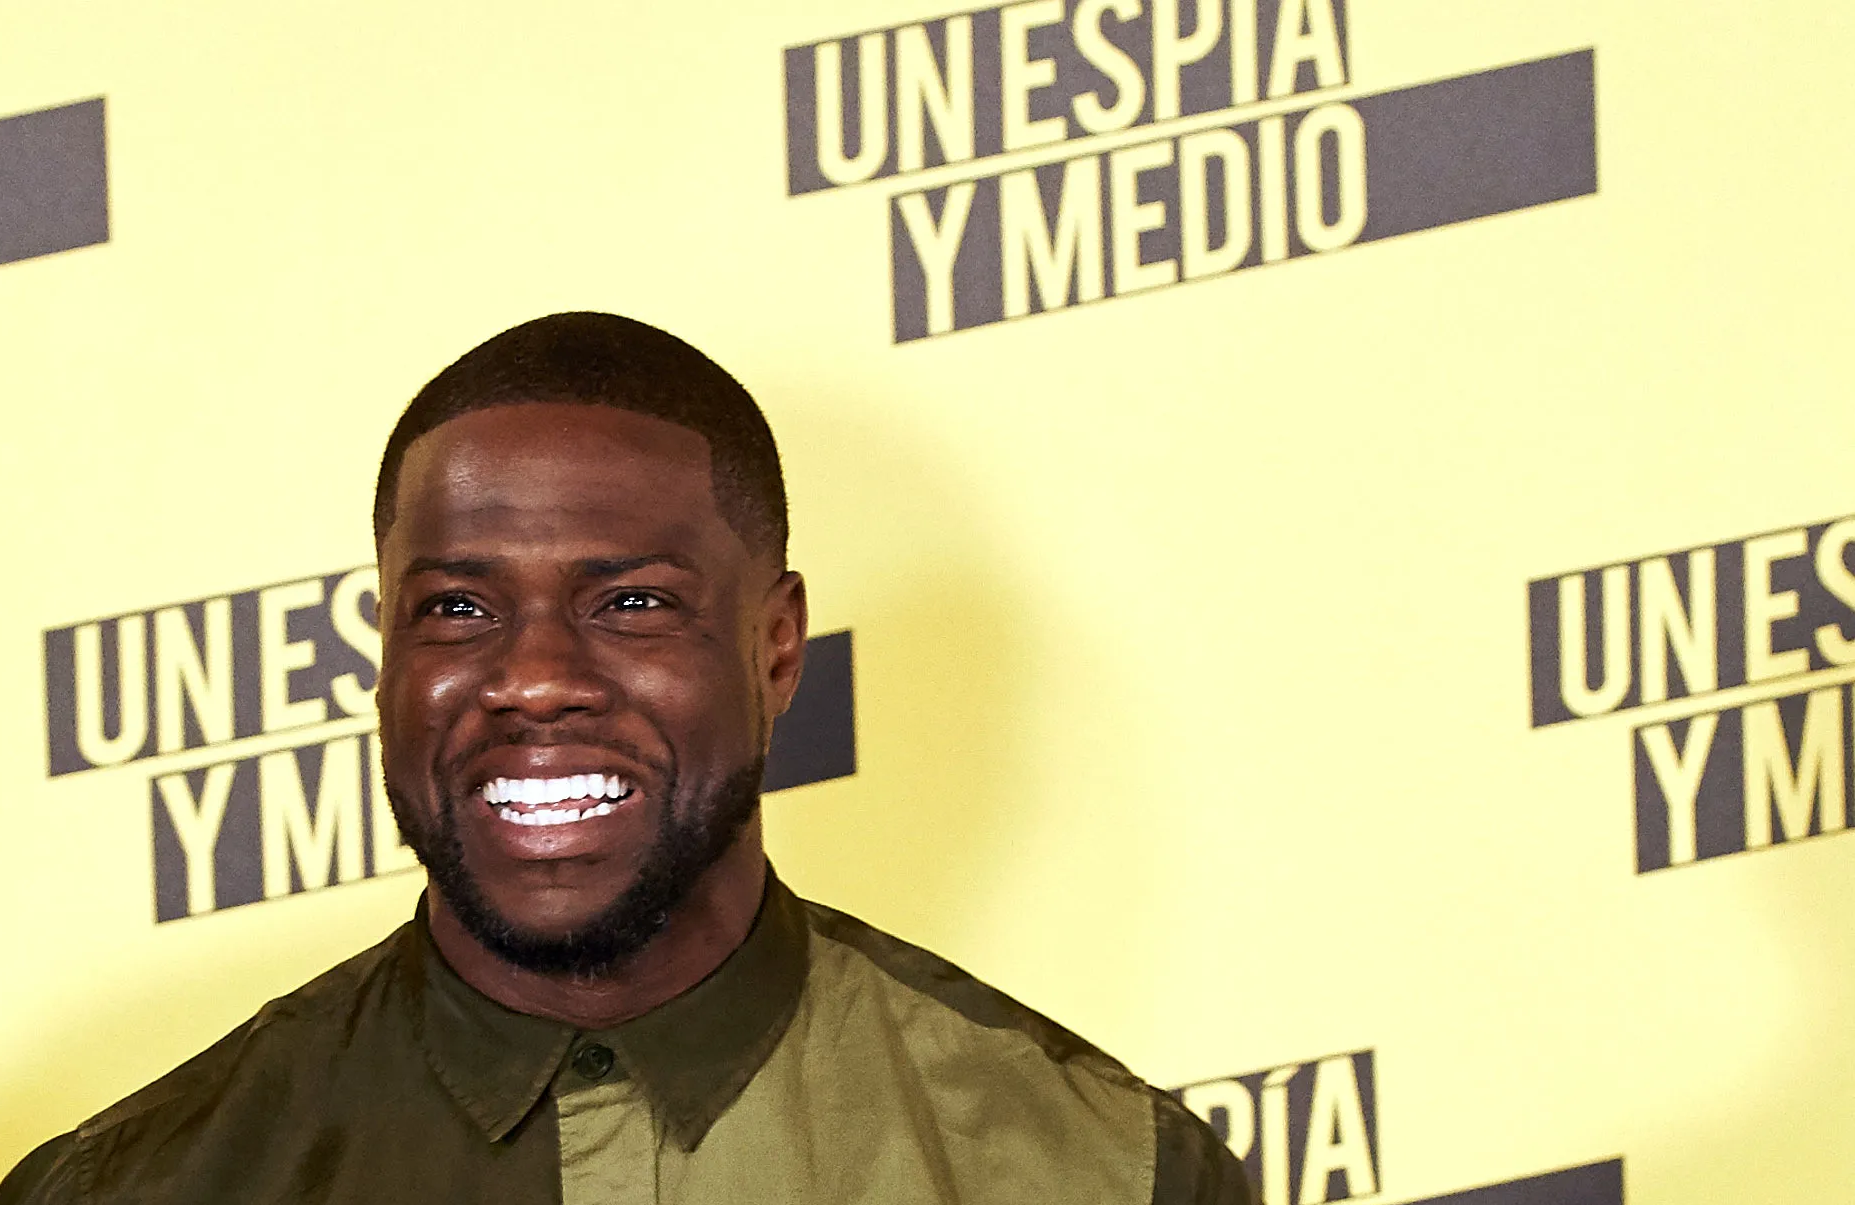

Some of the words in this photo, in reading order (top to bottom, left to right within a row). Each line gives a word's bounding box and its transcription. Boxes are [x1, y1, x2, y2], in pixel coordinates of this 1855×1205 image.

[814, 18, 974, 186] UN
[898, 184, 975, 336] Y
[1000, 102, 1368, 320] MEDIO
[72, 597, 235, 767] UN
[1559, 546, 1719, 718] UN
[156, 760, 238, 917] Y
[1640, 712, 1720, 868] Y
